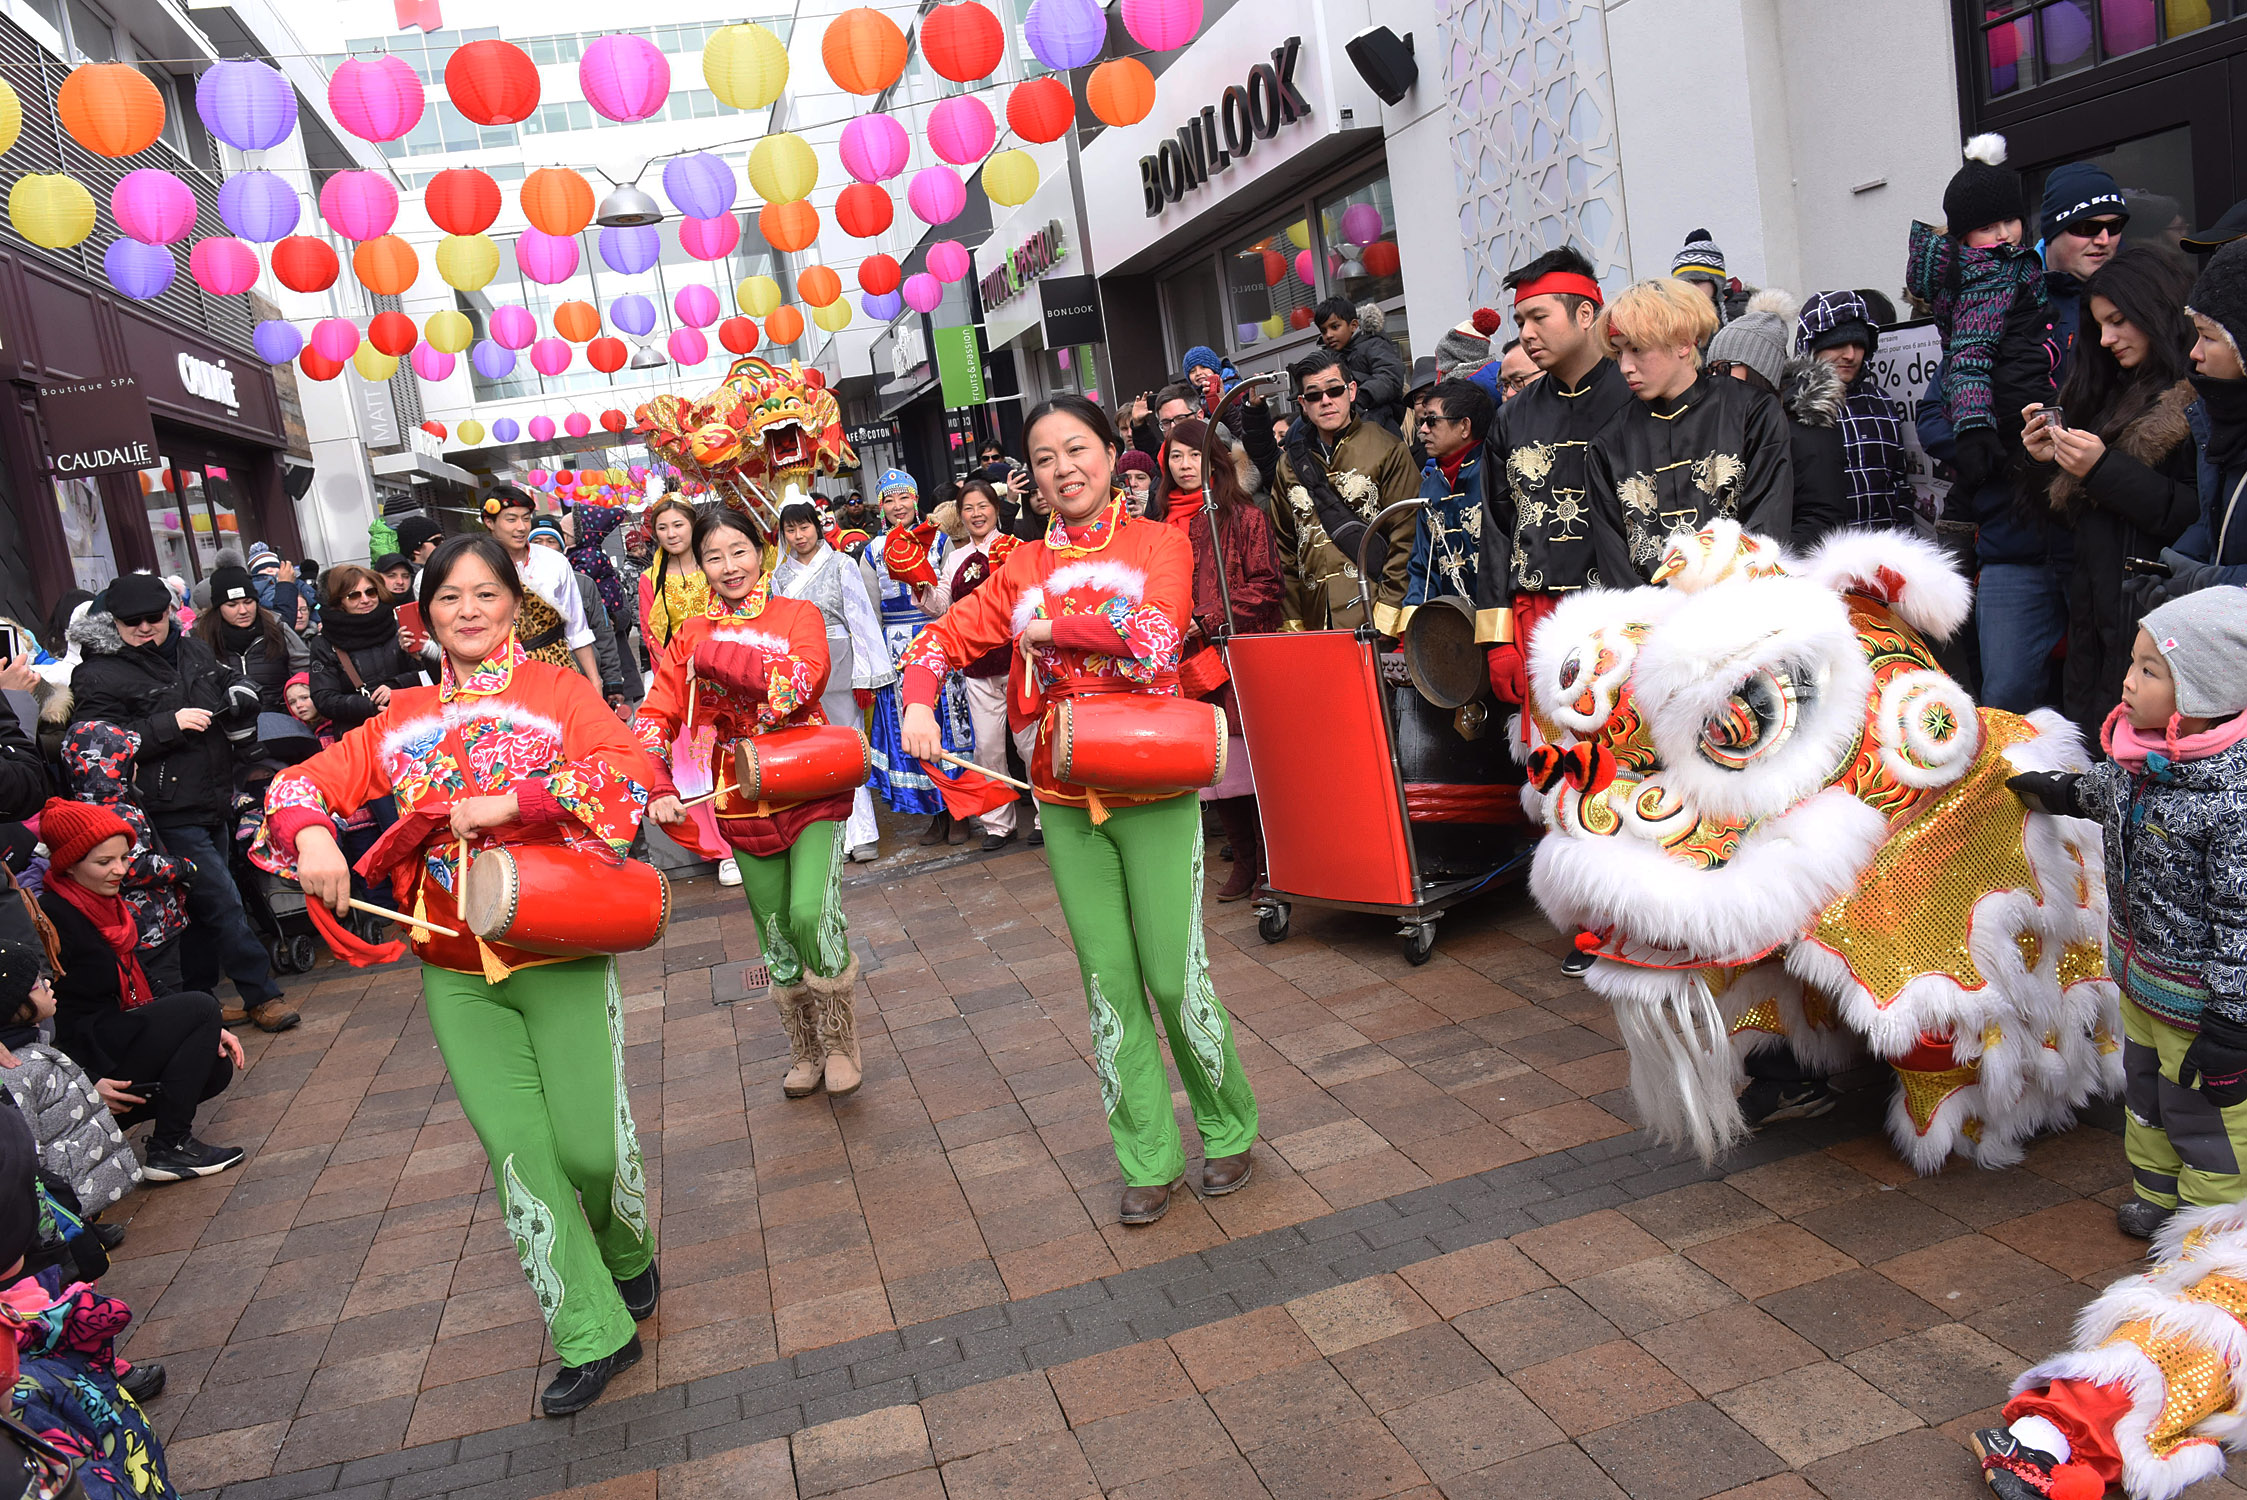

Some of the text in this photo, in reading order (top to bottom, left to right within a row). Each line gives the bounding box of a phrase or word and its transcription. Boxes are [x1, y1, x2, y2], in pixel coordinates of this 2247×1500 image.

[1139, 36, 1312, 218] BONLOOK
[1047, 304, 1094, 318] BONLOOK
[41, 377, 135, 396] Boutique SPA
[364, 389, 391, 441] MATT
[867, 427, 890, 440] COTON
